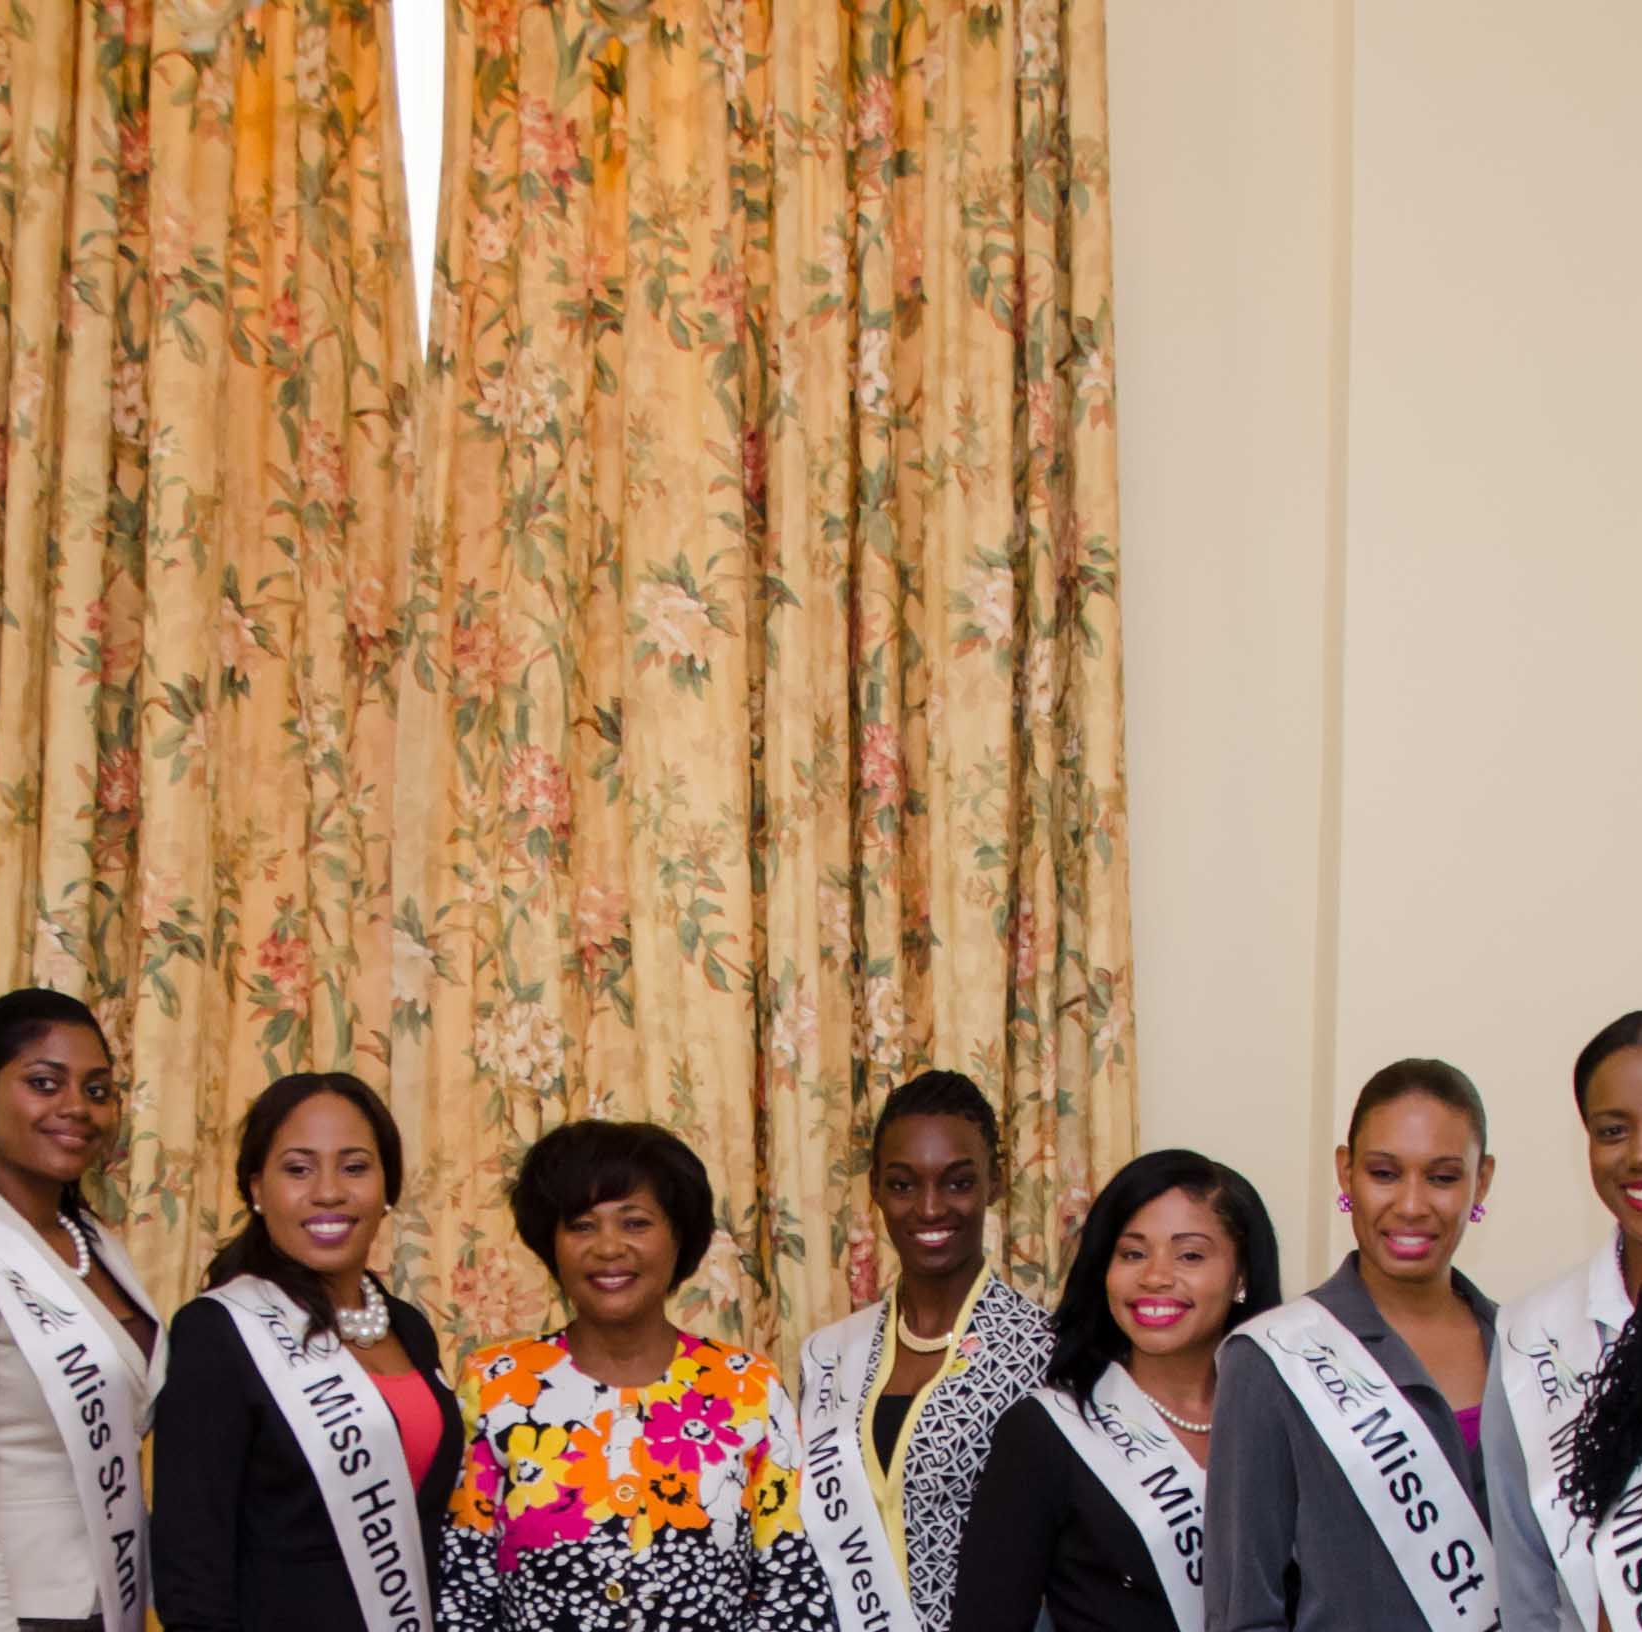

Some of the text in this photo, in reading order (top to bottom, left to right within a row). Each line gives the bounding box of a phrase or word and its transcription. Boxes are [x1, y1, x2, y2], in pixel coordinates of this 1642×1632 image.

[258, 1306, 311, 1369] JCDC
[1306, 1351, 1360, 1416] JCDC
[1530, 1350, 1563, 1413] JCDC
[302, 1374, 372, 1477] Miss
[56, 1343, 137, 1614] Miss St. Ann
[808, 1426, 848, 1522] Miss
[1350, 1407, 1438, 1534] Miss
[1430, 1539, 1484, 1616] St.
